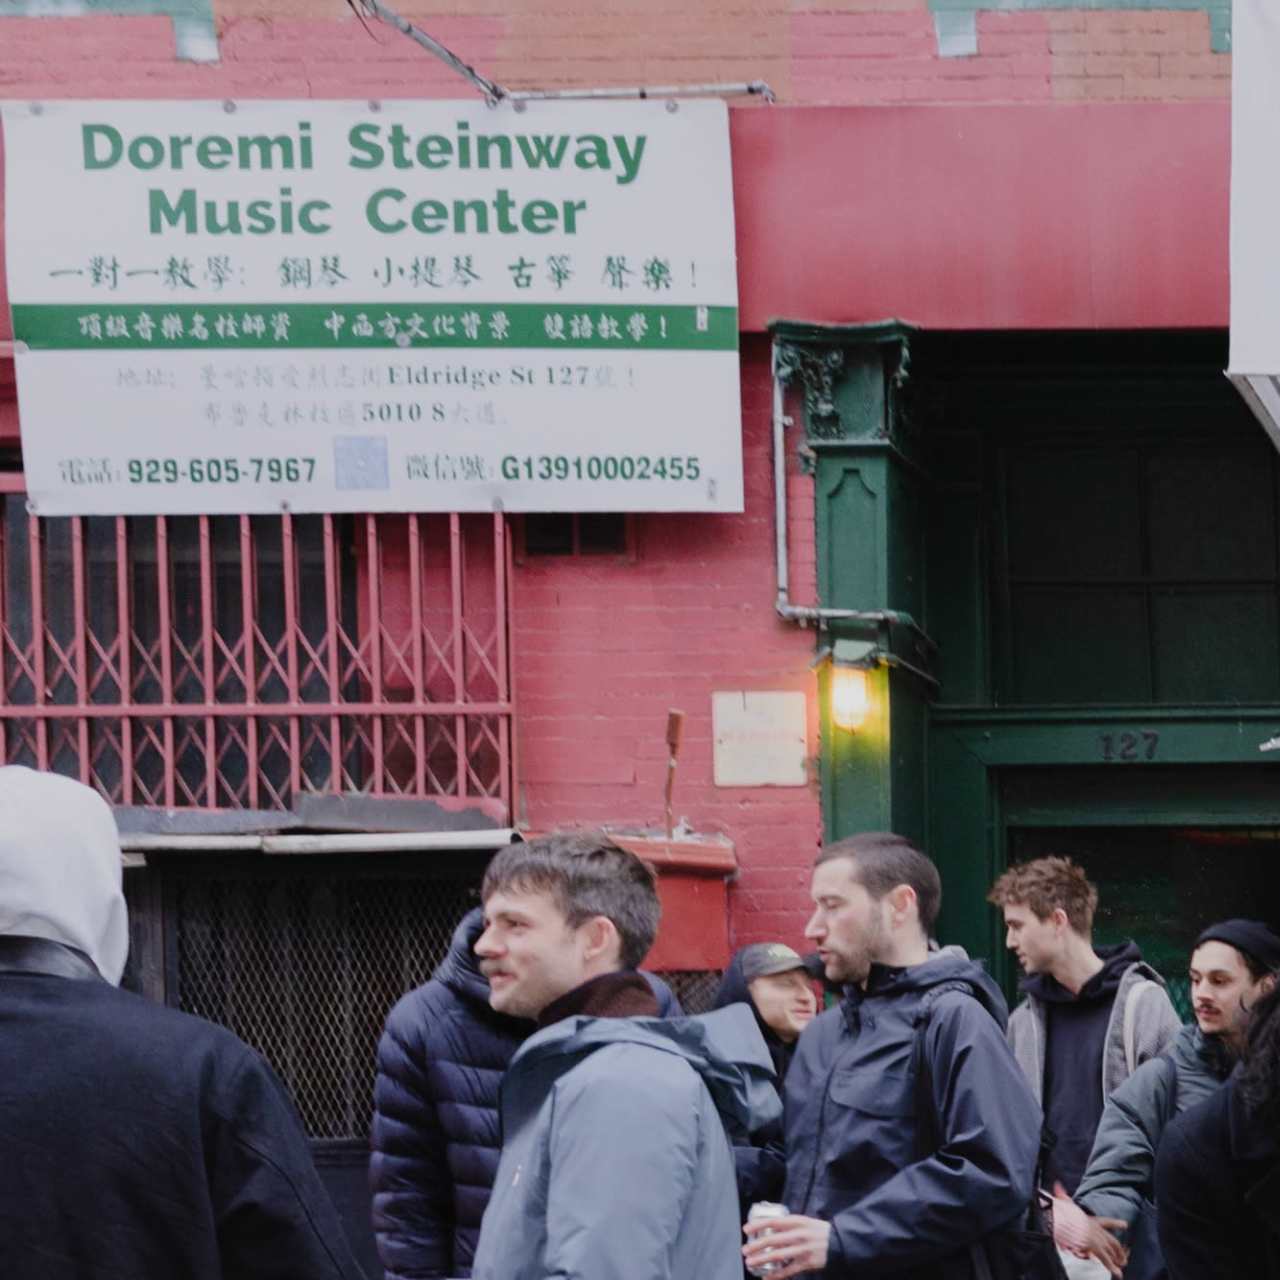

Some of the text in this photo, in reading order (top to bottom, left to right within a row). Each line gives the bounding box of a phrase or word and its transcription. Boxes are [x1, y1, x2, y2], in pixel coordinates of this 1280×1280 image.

[81, 120, 648, 183] Doremi Steinway
[148, 187, 588, 235] Music Center
[278, 255, 350, 290] 鋼琴
[372, 255, 483, 290] 小提琴
[509, 365, 535, 386] St
[546, 365, 590, 386] 127
[361, 402, 424, 424] 5010
[126, 456, 317, 485] 929-605-7967
[500, 453, 702, 483] G13910002455
[1101, 731, 1159, 760] 127
